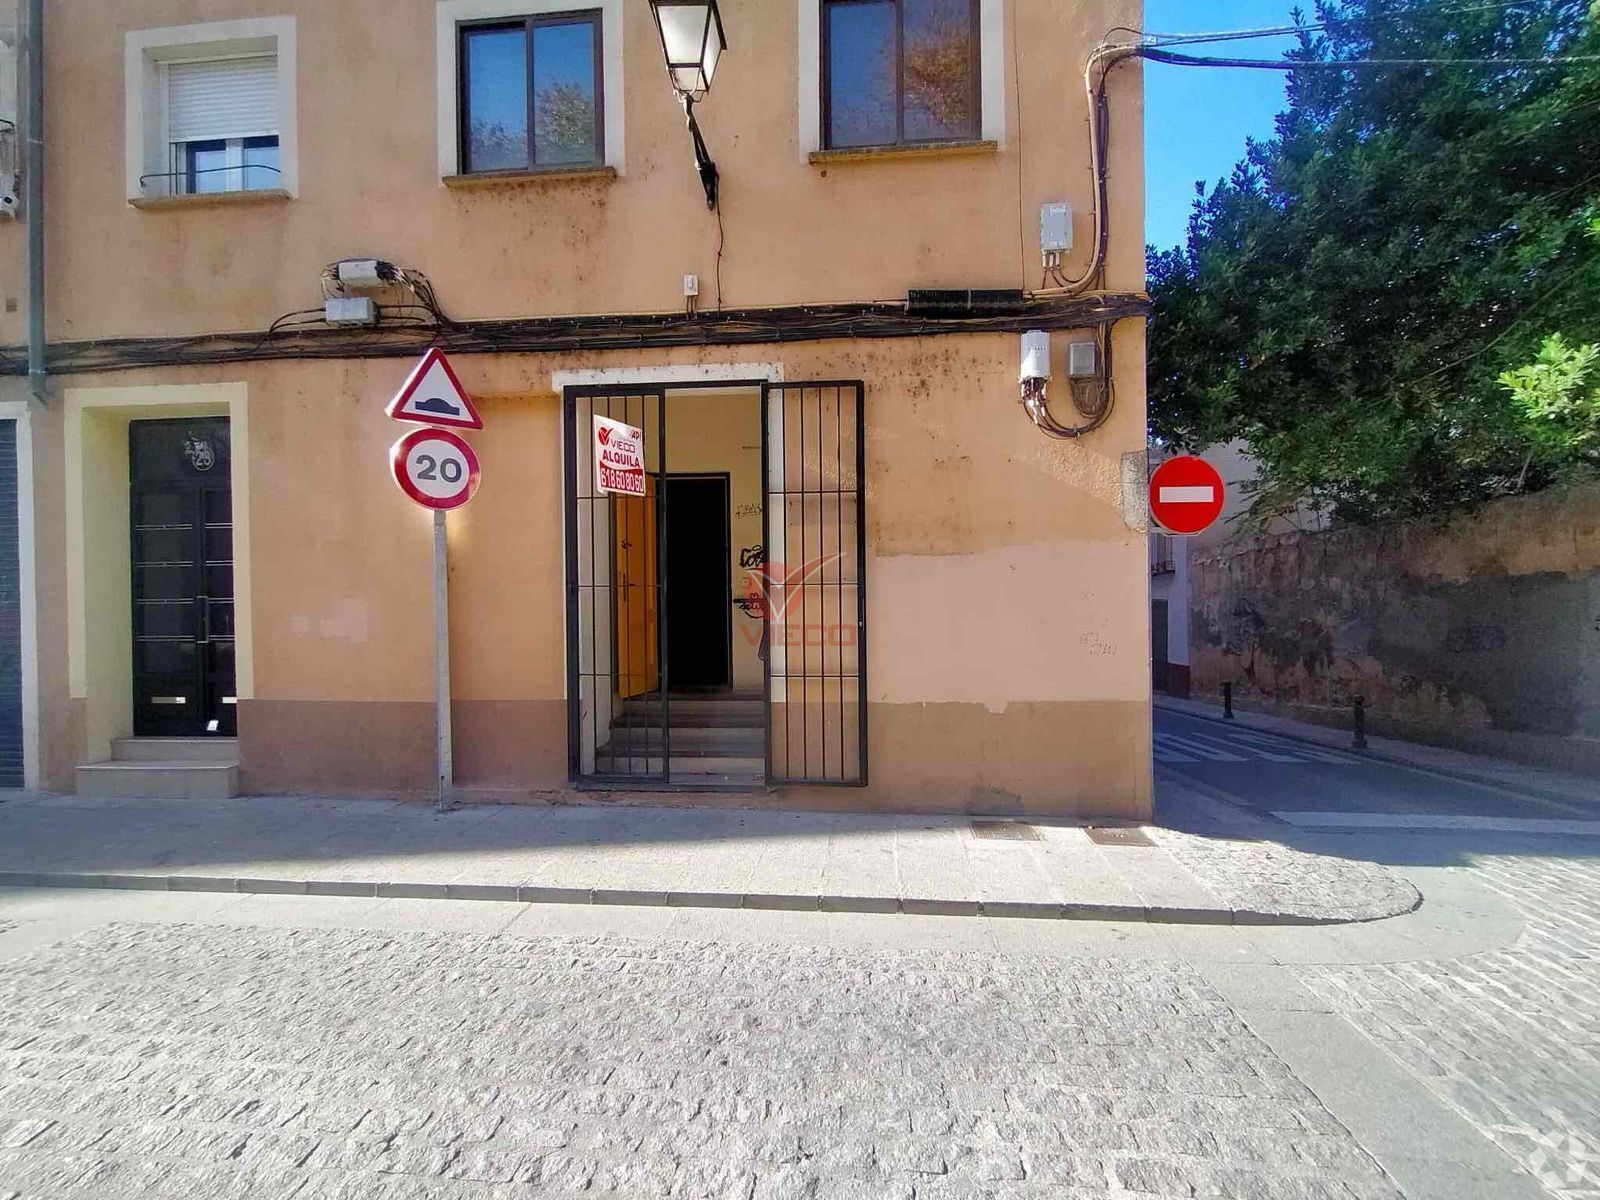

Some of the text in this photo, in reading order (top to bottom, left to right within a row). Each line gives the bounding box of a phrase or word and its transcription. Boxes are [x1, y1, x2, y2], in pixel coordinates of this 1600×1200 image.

[611, 439, 636, 453] VIECO
[602, 449, 640, 467] ALQUILA
[416, 454, 462, 483] 20
